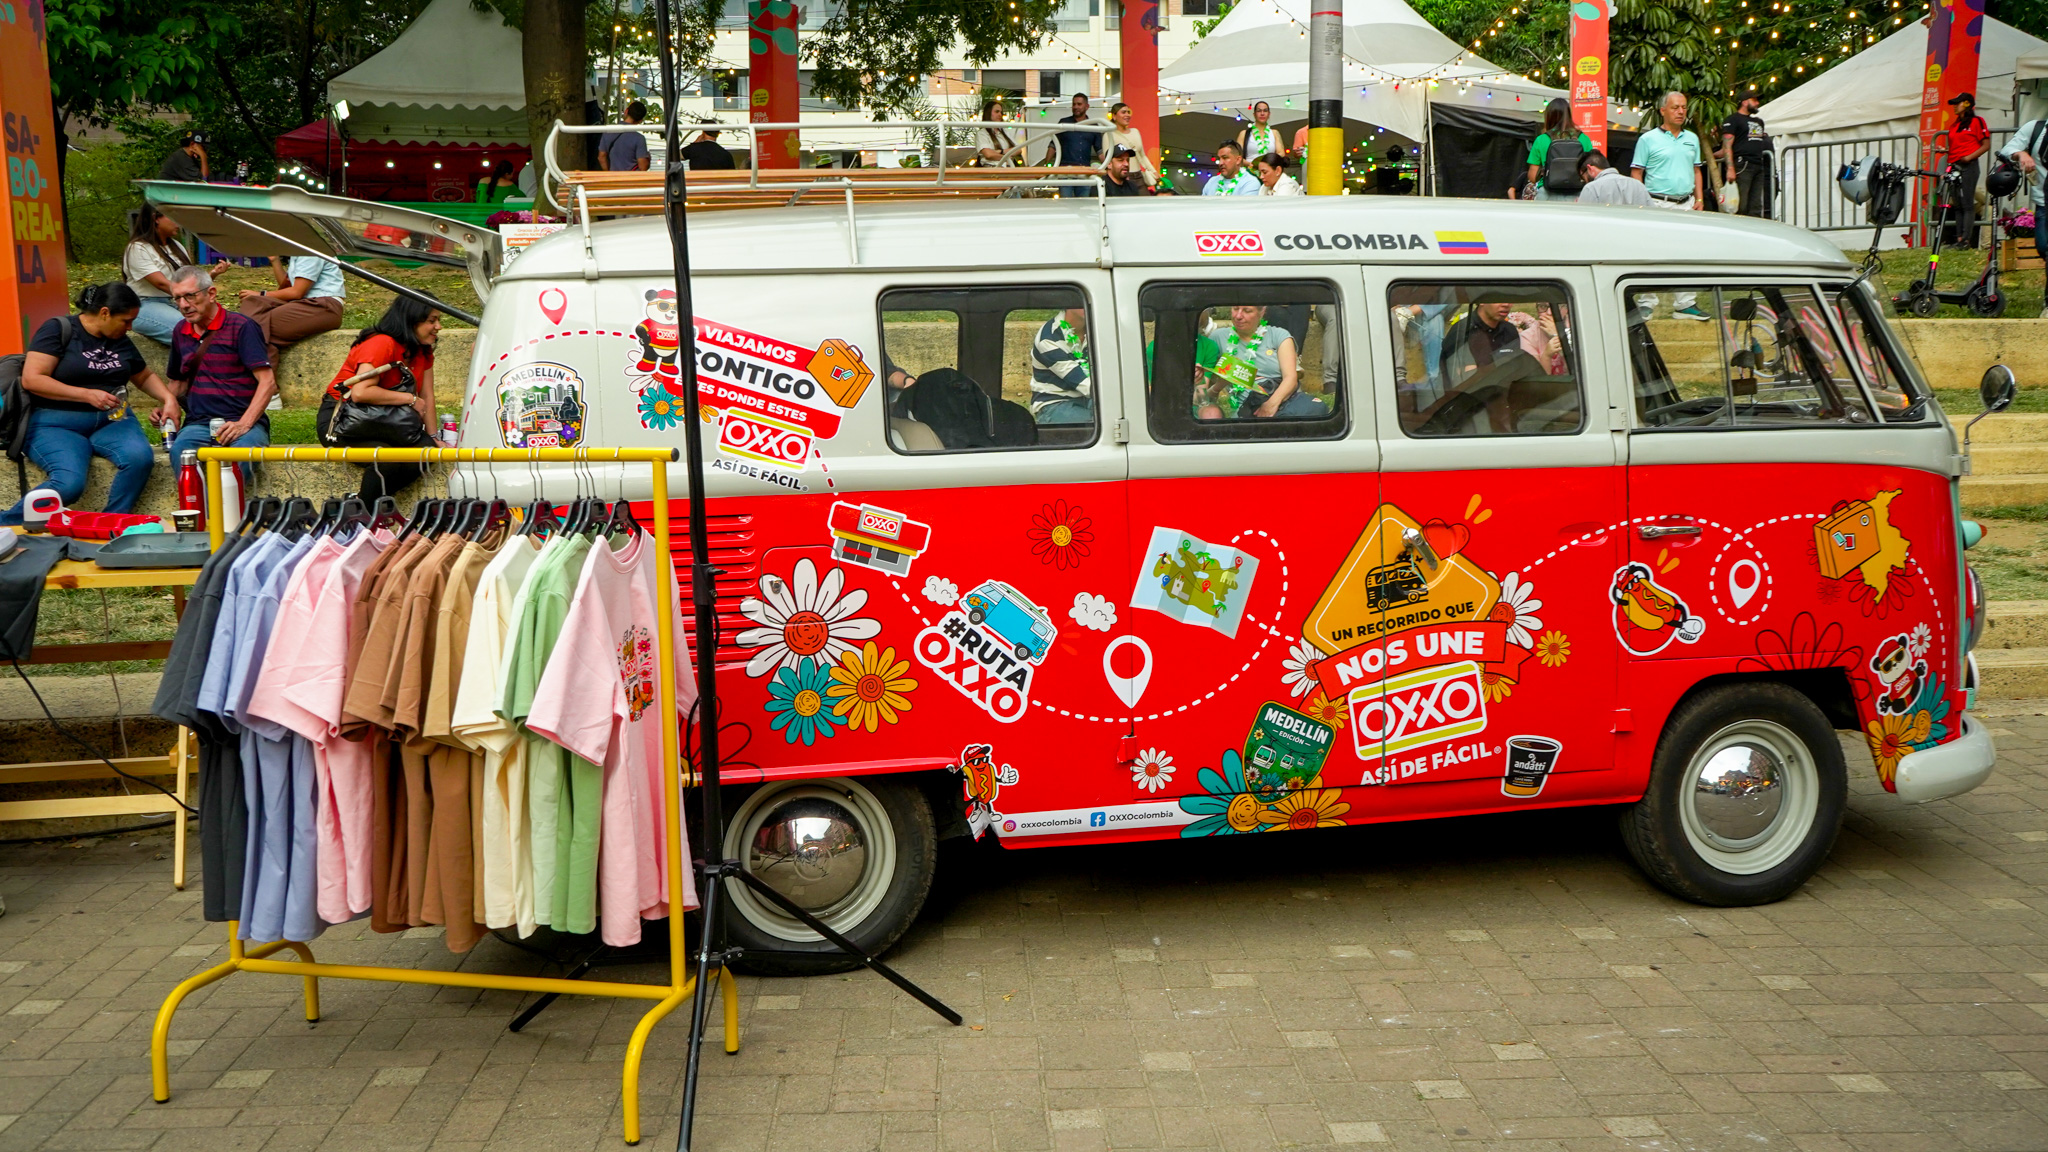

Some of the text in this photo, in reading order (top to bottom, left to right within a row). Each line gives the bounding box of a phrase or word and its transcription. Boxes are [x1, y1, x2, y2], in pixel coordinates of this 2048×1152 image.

[4, 111, 40, 155] SA-
[8, 156, 48, 199] BO-
[13, 200, 61, 242] REA-
[1198, 233, 1429, 252] OXXO COLOMBIA
[16, 244, 47, 284] LA
[657, 330, 676, 338] OXXO
[704, 325, 797, 363] VIAJAMOS
[511, 367, 565, 383] MEDELLÍN
[674, 376, 808, 422] EES DONDE ESTES
[528, 436, 558, 448] OXXO
[725, 420, 807, 461] OXXO
[712, 459, 737, 473] ASÍ
[739, 464, 757, 478] DE
[864, 516, 897, 532] OXXO
[1332, 601, 1475, 642] UN RECORRIDO QUE
[943, 617, 1028, 692] #RUTA
[1335, 631, 1485, 686] NOS UNE
[919, 632, 1022, 718] OXXO
[1264, 707, 1329, 745] MEDELLÍN
[1358, 679, 1478, 742] OXXO
[1279, 730, 1305, 745] EDICIÓN
[1360, 762, 1397, 786] ASÍ
[1400, 756, 1428, 777] DE
[1514, 760, 1547, 771] andatti
[1020, 810, 1174, 829] oxxocolombia OXXOcolombia
